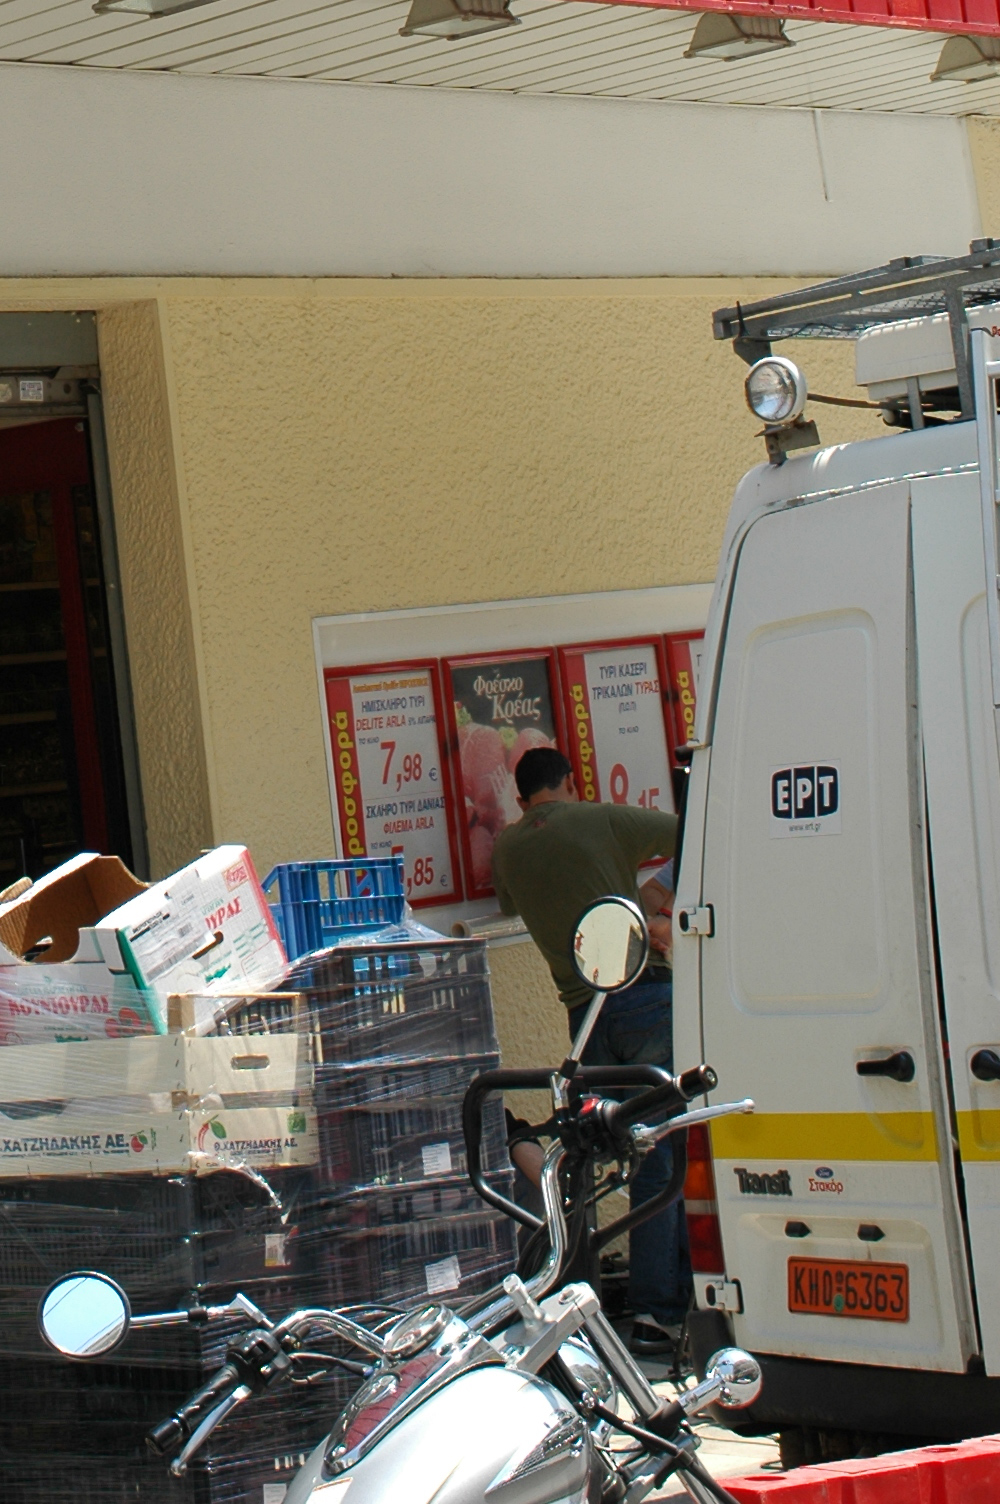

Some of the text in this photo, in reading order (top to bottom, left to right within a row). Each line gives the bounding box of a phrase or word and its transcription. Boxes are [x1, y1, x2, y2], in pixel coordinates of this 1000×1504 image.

[599, 662, 647, 680] ΤΥΡΙ ΚΑΣΕΡΙ
[473, 673, 524, 700] Φρέσκο
[592, 679, 660, 700] ΤΡΙΚΑΛΩΝ ΤΥΡΑΣ
[361, 695, 425, 713] ΗΜΙΣΚΛΗΡΟ ΤΥΡΙ
[492, 691, 541, 724] Κρέας
[356, 716, 384, 731] DELITE
[386, 714, 407, 728] ARLA
[331, 710, 367, 876] ροσφορά
[776, 775, 834, 811] ΕΡΤ
[366, 796, 445, 819] ΣΚΛΗΡΟ ΤΥΡΙ ΔΑΝΙΑΣ
[415, 816, 435, 830] ARLA
[733, 1167, 793, 1196] Transit
[808, 1178, 844, 1195] Στακόρ
